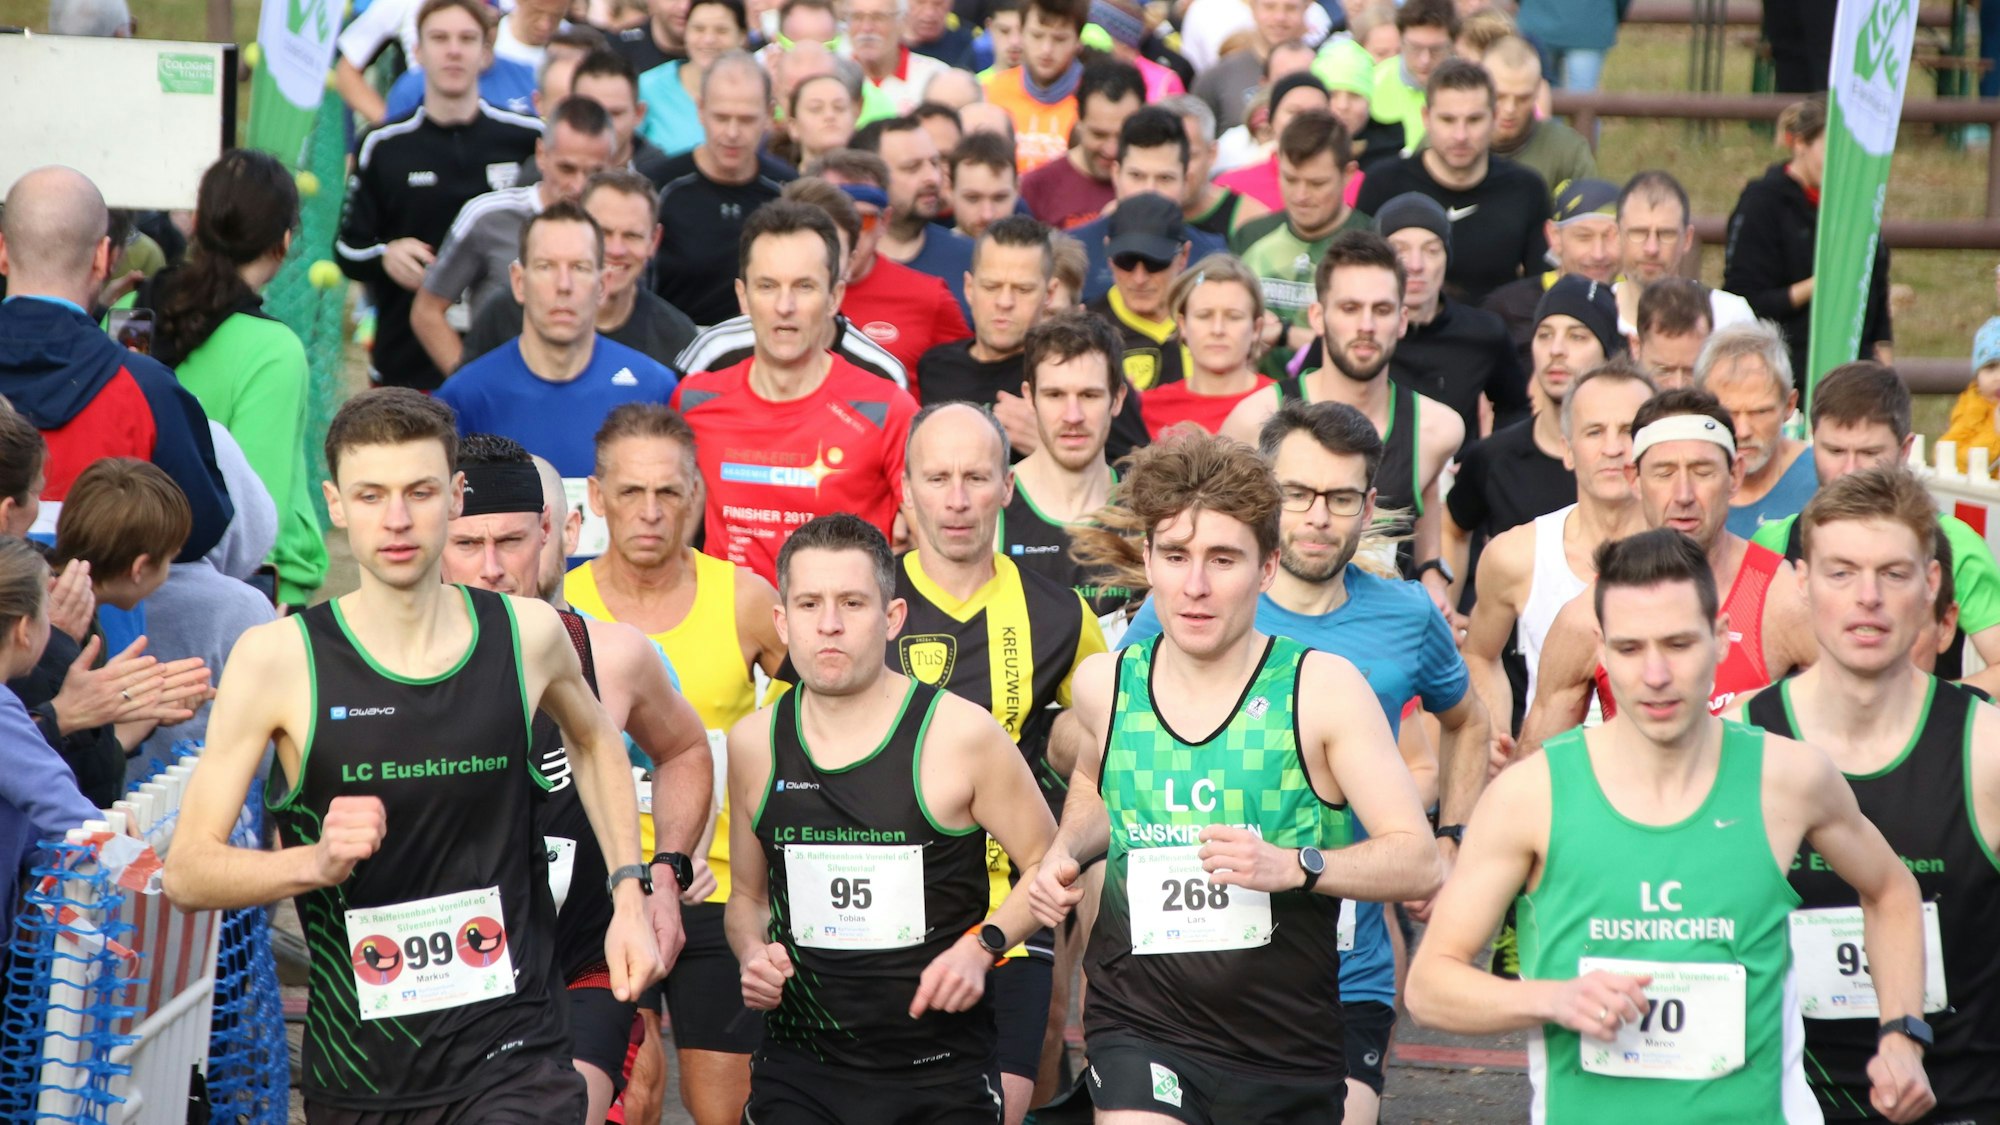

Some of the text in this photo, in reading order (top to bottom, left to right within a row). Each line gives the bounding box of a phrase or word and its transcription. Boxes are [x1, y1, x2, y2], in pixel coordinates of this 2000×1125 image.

[164, 60, 213, 70] COLOGNE
[722, 505, 815, 525] FINISHER 2017
[914, 650, 944, 666] TuS
[342, 755, 508, 782] LC Euskirchen
[1165, 778, 1217, 812] LC
[774, 826, 906, 843] LC Euskirchen
[830, 877, 872, 909] 95
[1161, 878, 1229, 911] 268
[1640, 881, 1683, 912] LC
[372, 906, 437, 923] Raiffeisenbank
[838, 914, 866, 922] Tobias
[397, 917, 452, 933] Silvesterlauf
[1590, 918, 1735, 941] EUSKIRCHEN
[404, 931, 453, 970] 99
[416, 973, 450, 983] Markus
[1640, 998, 1686, 1032] 70
[1645, 1038, 1676, 1048] Marco
